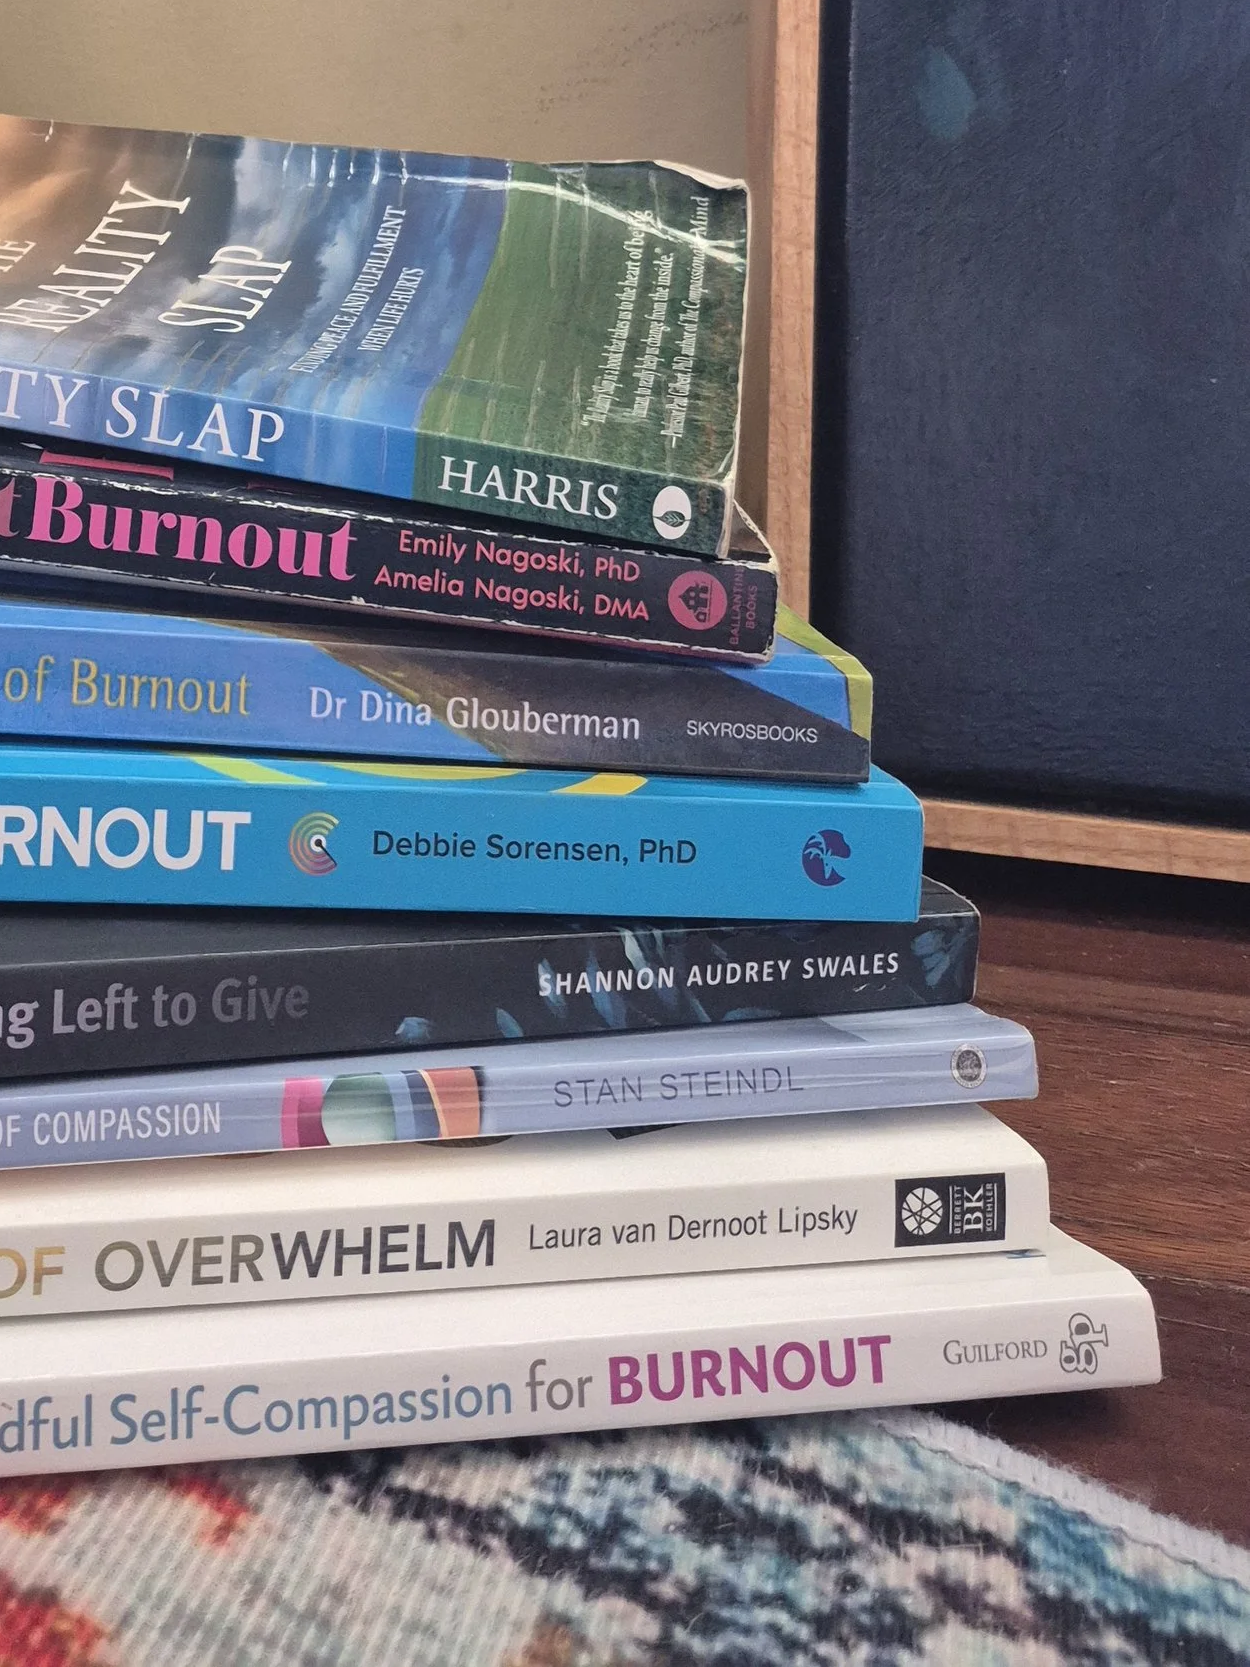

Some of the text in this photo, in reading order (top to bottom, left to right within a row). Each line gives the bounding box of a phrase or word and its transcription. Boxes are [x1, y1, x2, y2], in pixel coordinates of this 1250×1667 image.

[690, 196, 710, 237] Mind
[617, 260, 641, 287] heart
[623, 244, 643, 260] of
[158, 245, 293, 333] SLAP
[288, 205, 407, 373] FINDING PEACE AND FULFILLMENT
[357, 267, 424, 351] WHEN LIFE HURTS
[615, 287, 637, 302] the
[645, 302, 667, 321] from
[648, 286, 670, 302] the
[607, 320, 631, 339] takes
[640, 320, 670, 347] change
[678, 309, 699, 321] The
[598, 353, 623, 370] book
[603, 338, 626, 353] that
[674, 332, 695, 356] author
[104, 384, 286, 464] SLAP
[439, 456, 619, 521] HARRIS
[27, 476, 359, 582] Burnout
[398, 530, 641, 582] Emily Nagoski, PhD
[374, 564, 649, 622] Amelia Nagoski, DMA
[745, 585, 758, 630] BOOKS
[4, 656, 56, 703] of
[69, 659, 251, 716] Burnout
[309, 686, 641, 740] Dr Dina Glouberman
[686, 720, 819, 744] SKYROSBOOKS
[373, 829, 697, 866] Debbie Sorensen, PhD
[537, 952, 901, 997] SHANNON AUDREY SWALES
[52, 982, 139, 1035] Left
[151, 985, 198, 1027] to
[211, 976, 309, 1025] Give
[553, 1066, 805, 1108] STAN STEINDL
[33, 1102, 221, 1146] COMPASSION
[529, 1204, 859, 1251] Laura van Dernoot Lipsky
[953, 1185, 963, 1234] BERRETT
[963, 1184, 984, 1234] BK
[985, 1183, 993, 1232] KOEHLER
[94, 1219, 496, 1292] OVERWHELM
[943, 1340, 1048, 1365] GUILFORD
[109, 1374, 512, 1445] Self-Compassion
[525, 1359, 593, 1412] for
[609, 1334, 892, 1405] BURNOUT
